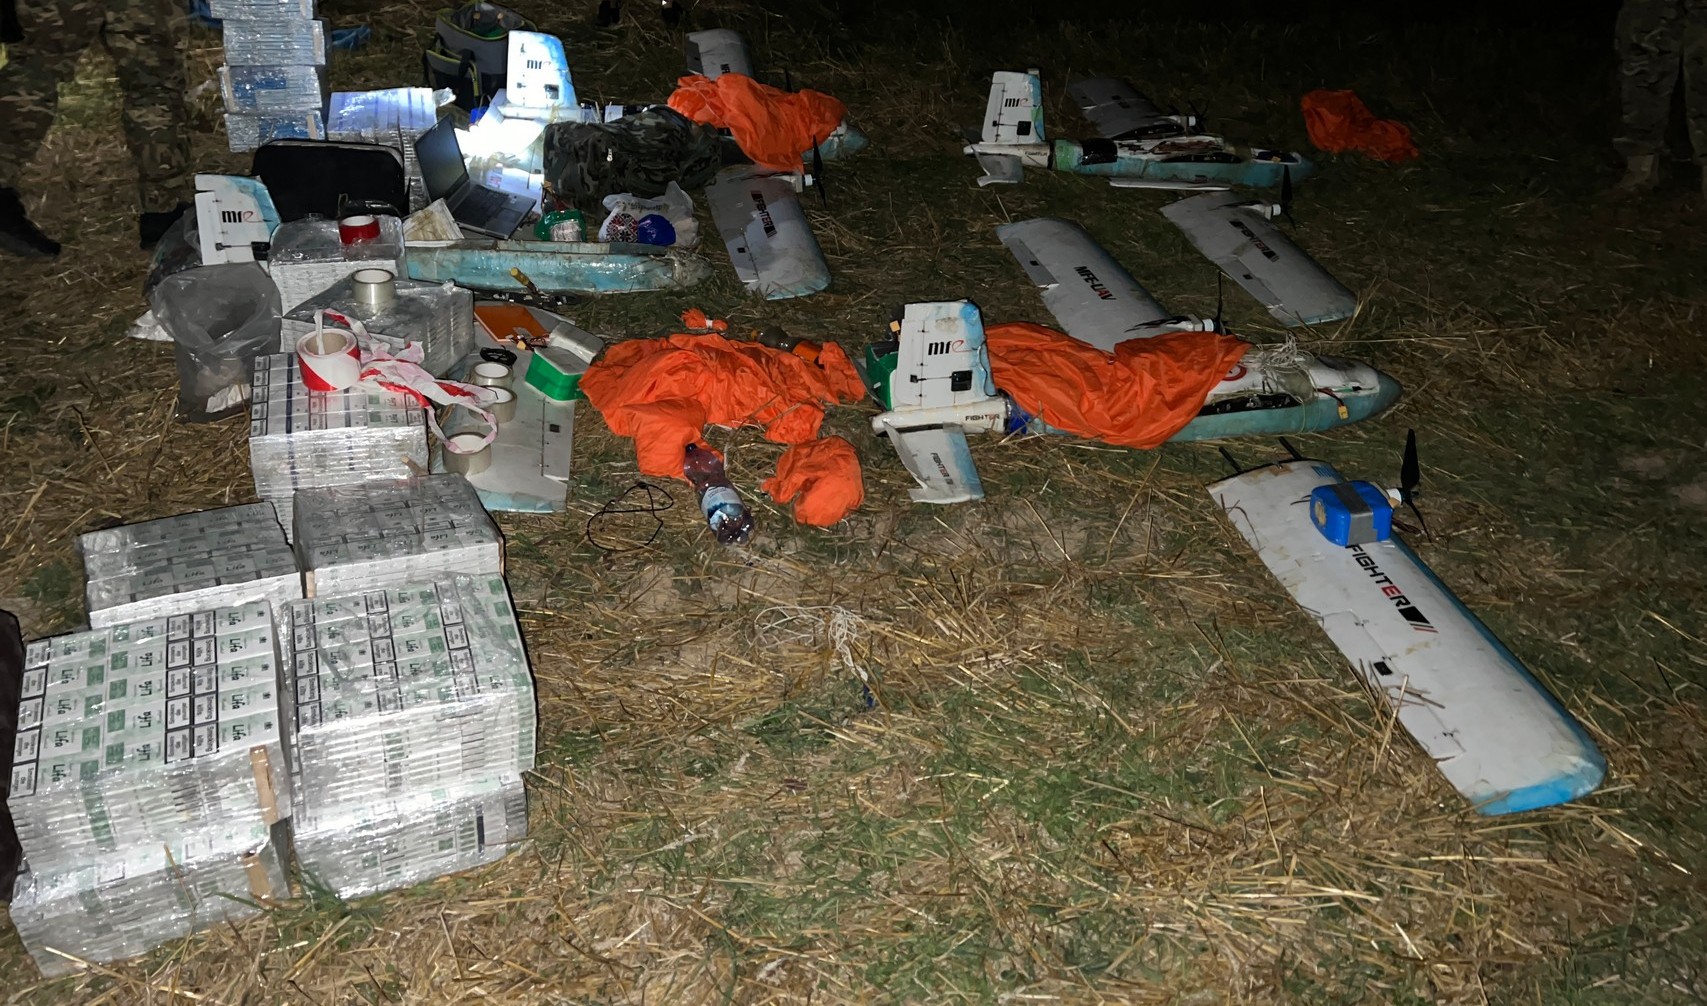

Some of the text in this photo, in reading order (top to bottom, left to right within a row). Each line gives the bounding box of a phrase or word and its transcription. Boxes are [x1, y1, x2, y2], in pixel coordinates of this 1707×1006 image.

[1345, 544, 1411, 608] FIGHTER
[228, 612, 242, 626] Lifa
[230, 638, 243, 652] Lifa
[140, 652, 153, 667] Lifa
[232, 666, 245, 681] Lifa
[138, 680, 152, 696] Lifa
[58, 698, 72, 714] Lifa
[205, 696, 214, 720] Smoking
[232, 694, 246, 710] Lifa
[138, 710, 152, 728] Lifa
[55, 730, 70, 748] Lifa
[206, 726, 214, 752] Smoking
[232, 724, 247, 742] Lifa
[136, 744, 150, 762] Lifa
[52, 764, 67, 782] Lifa
